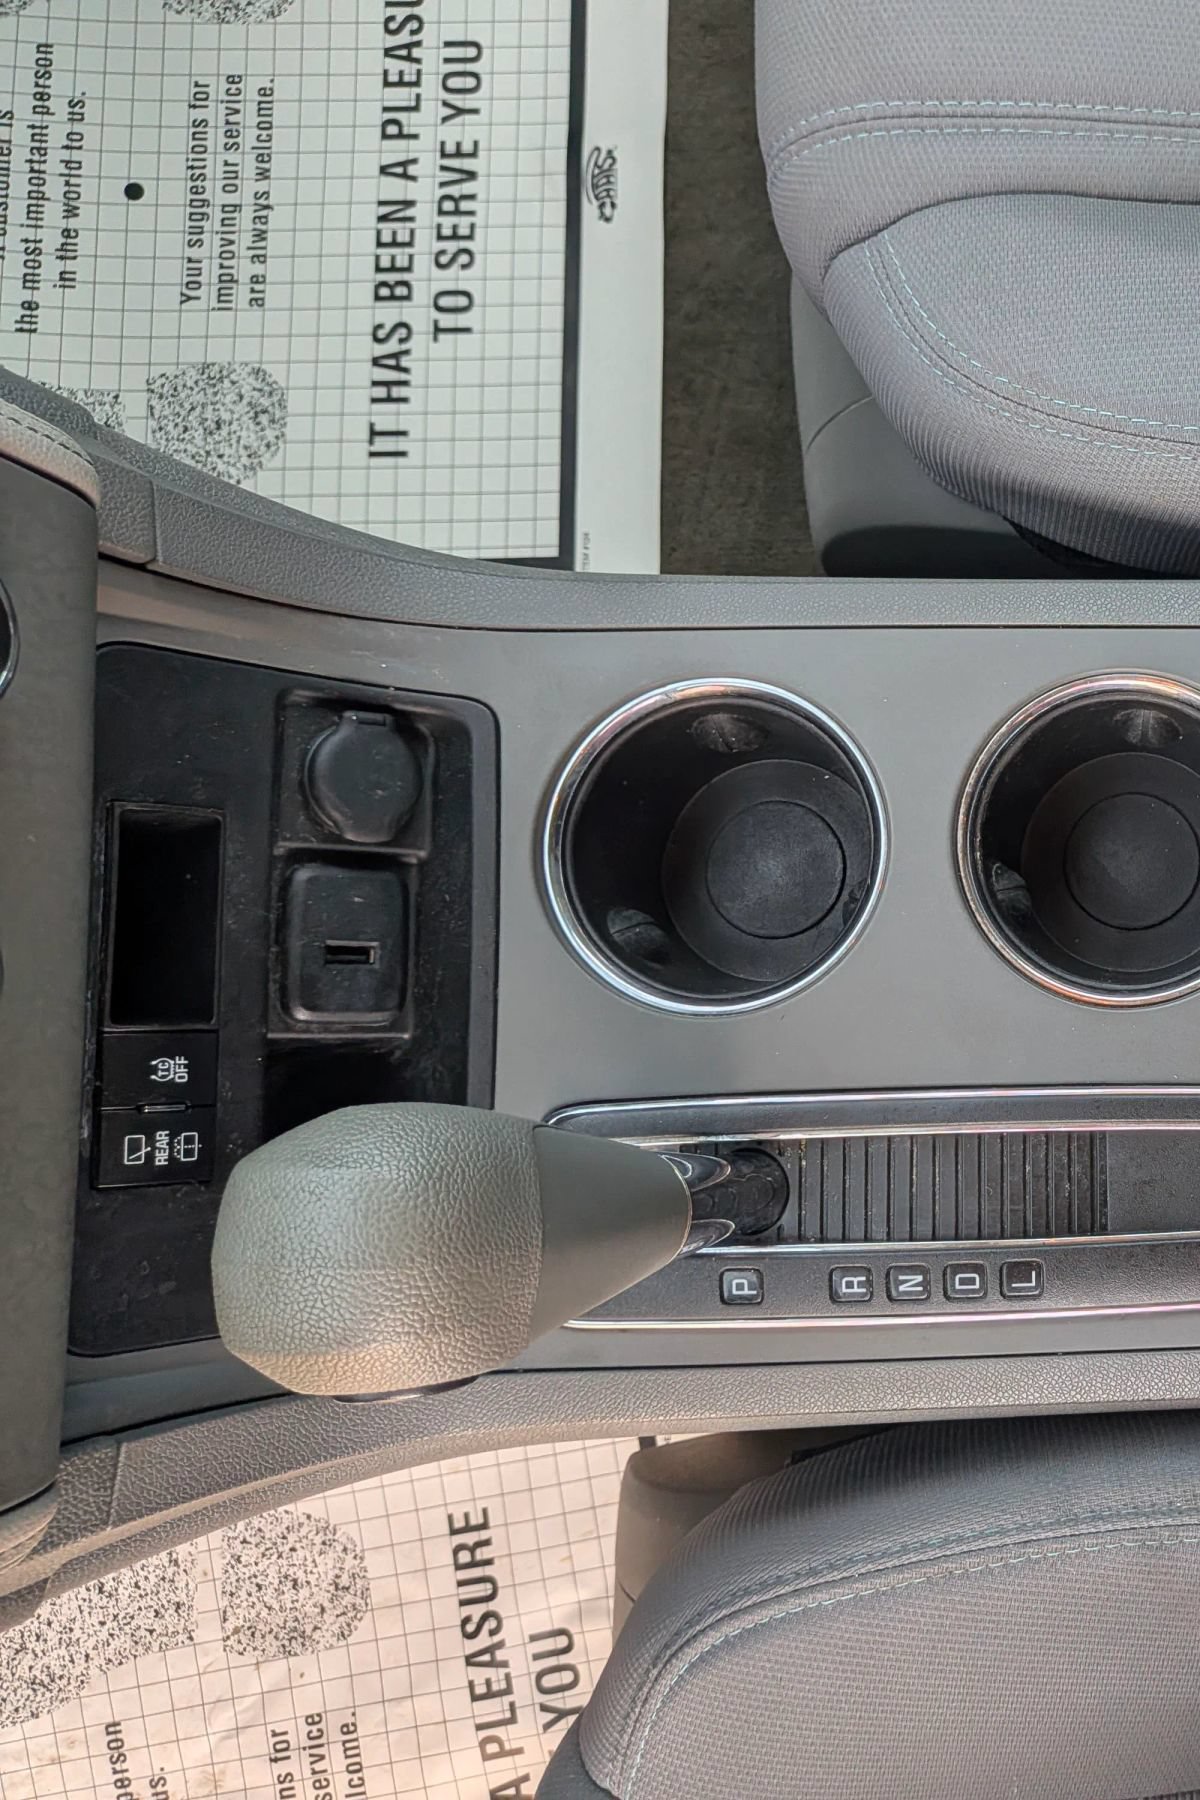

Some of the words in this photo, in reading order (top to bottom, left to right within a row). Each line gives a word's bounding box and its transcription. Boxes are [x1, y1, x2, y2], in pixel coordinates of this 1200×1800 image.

[32, 43, 55, 116] person
[188, 80, 211, 110] for
[441, 40, 482, 124] YOU
[67, 91, 87, 123] us.
[223, 74, 243, 152] service
[251, 78, 275, 183] welcome.
[61, 131, 84, 151] to
[20, 123, 51, 229] important
[59, 159, 83, 220] world
[185, 118, 211, 249] suggestions
[222, 159, 240, 194] our
[379, 158, 418, 183] A
[246, 190, 274, 265] always
[434, 140, 479, 270] SERVE
[20, 238, 43, 291] most
[54, 227, 79, 261] the
[211, 203, 243, 311] improving
[373, 199, 417, 302] BEEN
[52, 270, 77, 289] in
[179, 256, 203, 305] Your
[248, 274, 266, 308] are
[14, 300, 39, 335] the
[433, 290, 474, 343] TO
[370, 321, 412, 404] HAS
[368, 422, 408, 458] IT
[175, 1055, 189, 1083] OFF
[155, 1130, 170, 1166] REAR
[732, 1278, 757, 1295] P
[841, 1275, 867, 1293] R
[898, 1274, 923, 1291] N
[955, 1273, 980, 1290] D
[1012, 1270, 1036, 1288] L
[448, 1507, 525, 1763] PLEASURE
[529, 1626, 585, 1734] YOU
[104, 1721, 139, 1800] person
[268, 1729, 292, 1764] for
[302, 1713, 333, 1800] service
